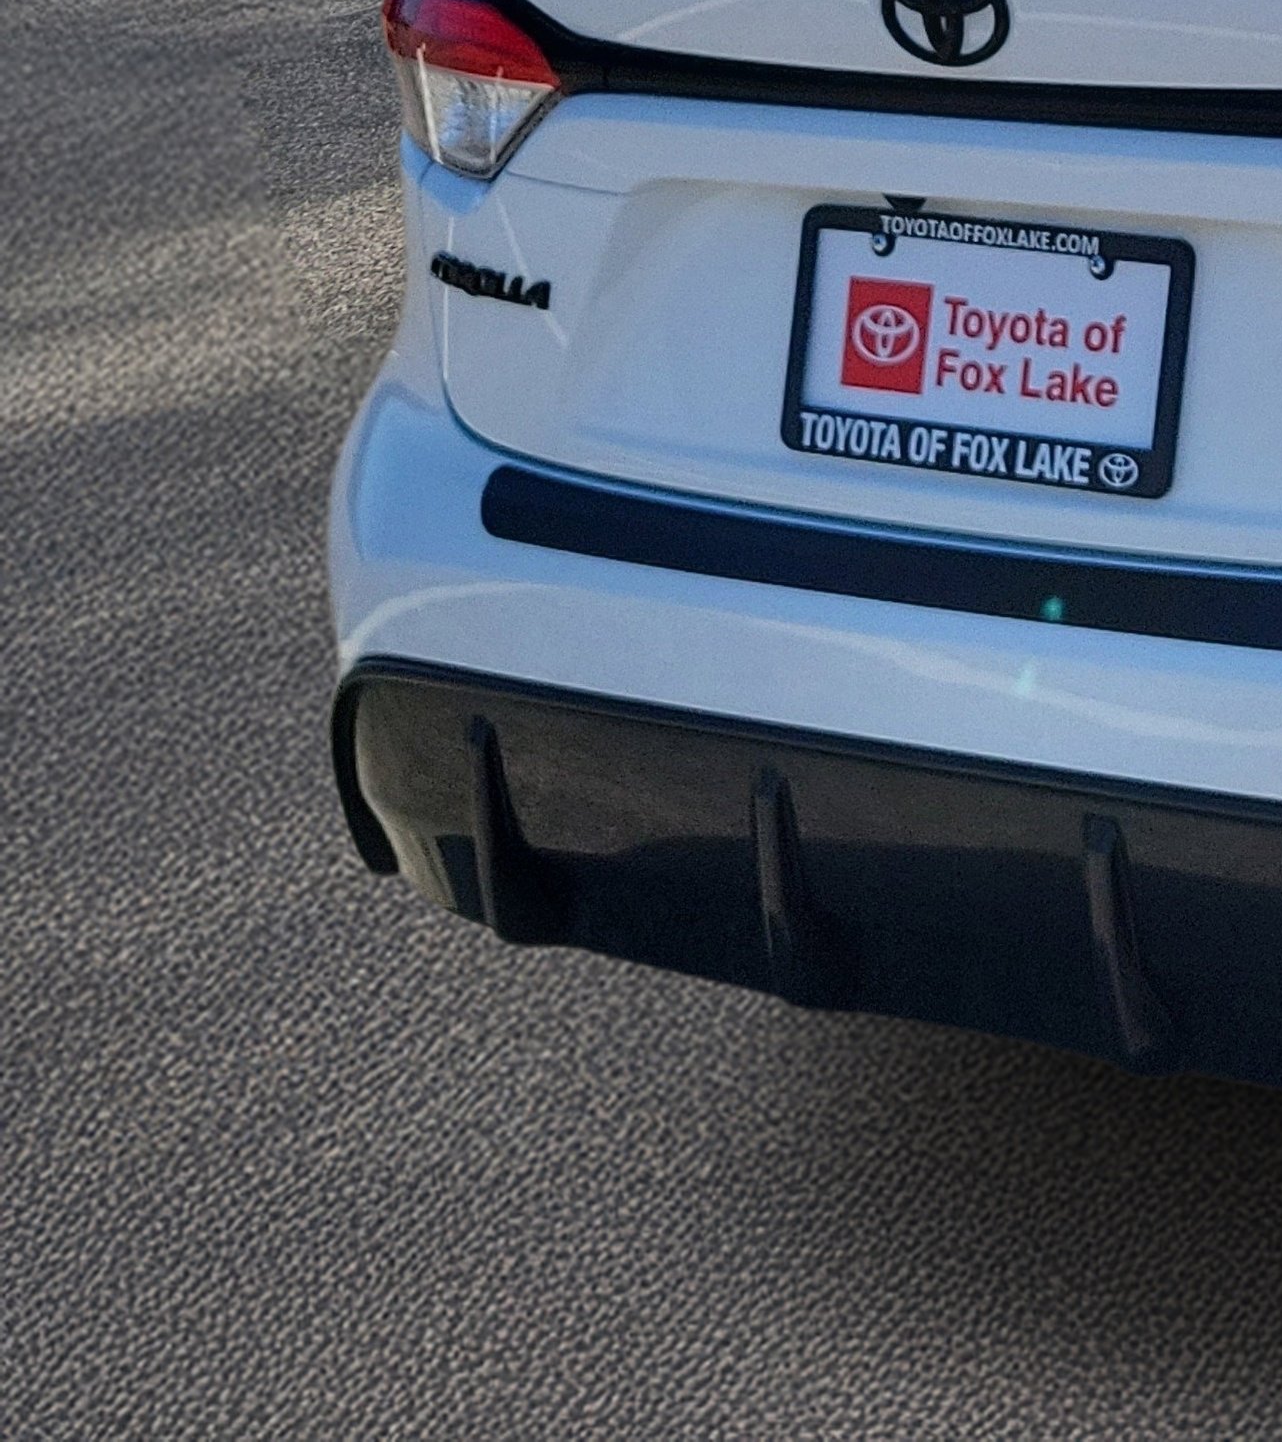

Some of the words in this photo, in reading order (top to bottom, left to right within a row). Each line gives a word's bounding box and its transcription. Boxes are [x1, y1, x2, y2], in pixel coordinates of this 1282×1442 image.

[880, 214, 1100, 256] TOYOTAOFFOXLAKE.COM
[944, 296, 1069, 351] Toyota
[1083, 312, 1127, 353] of
[936, 347, 1007, 395] Fox
[1020, 357, 1119, 408] Lake
[800, 411, 901, 459] TOYOTA
[908, 426, 949, 463] OF
[951, 432, 1010, 474] FOX
[1015, 439, 1093, 485] LAKE
